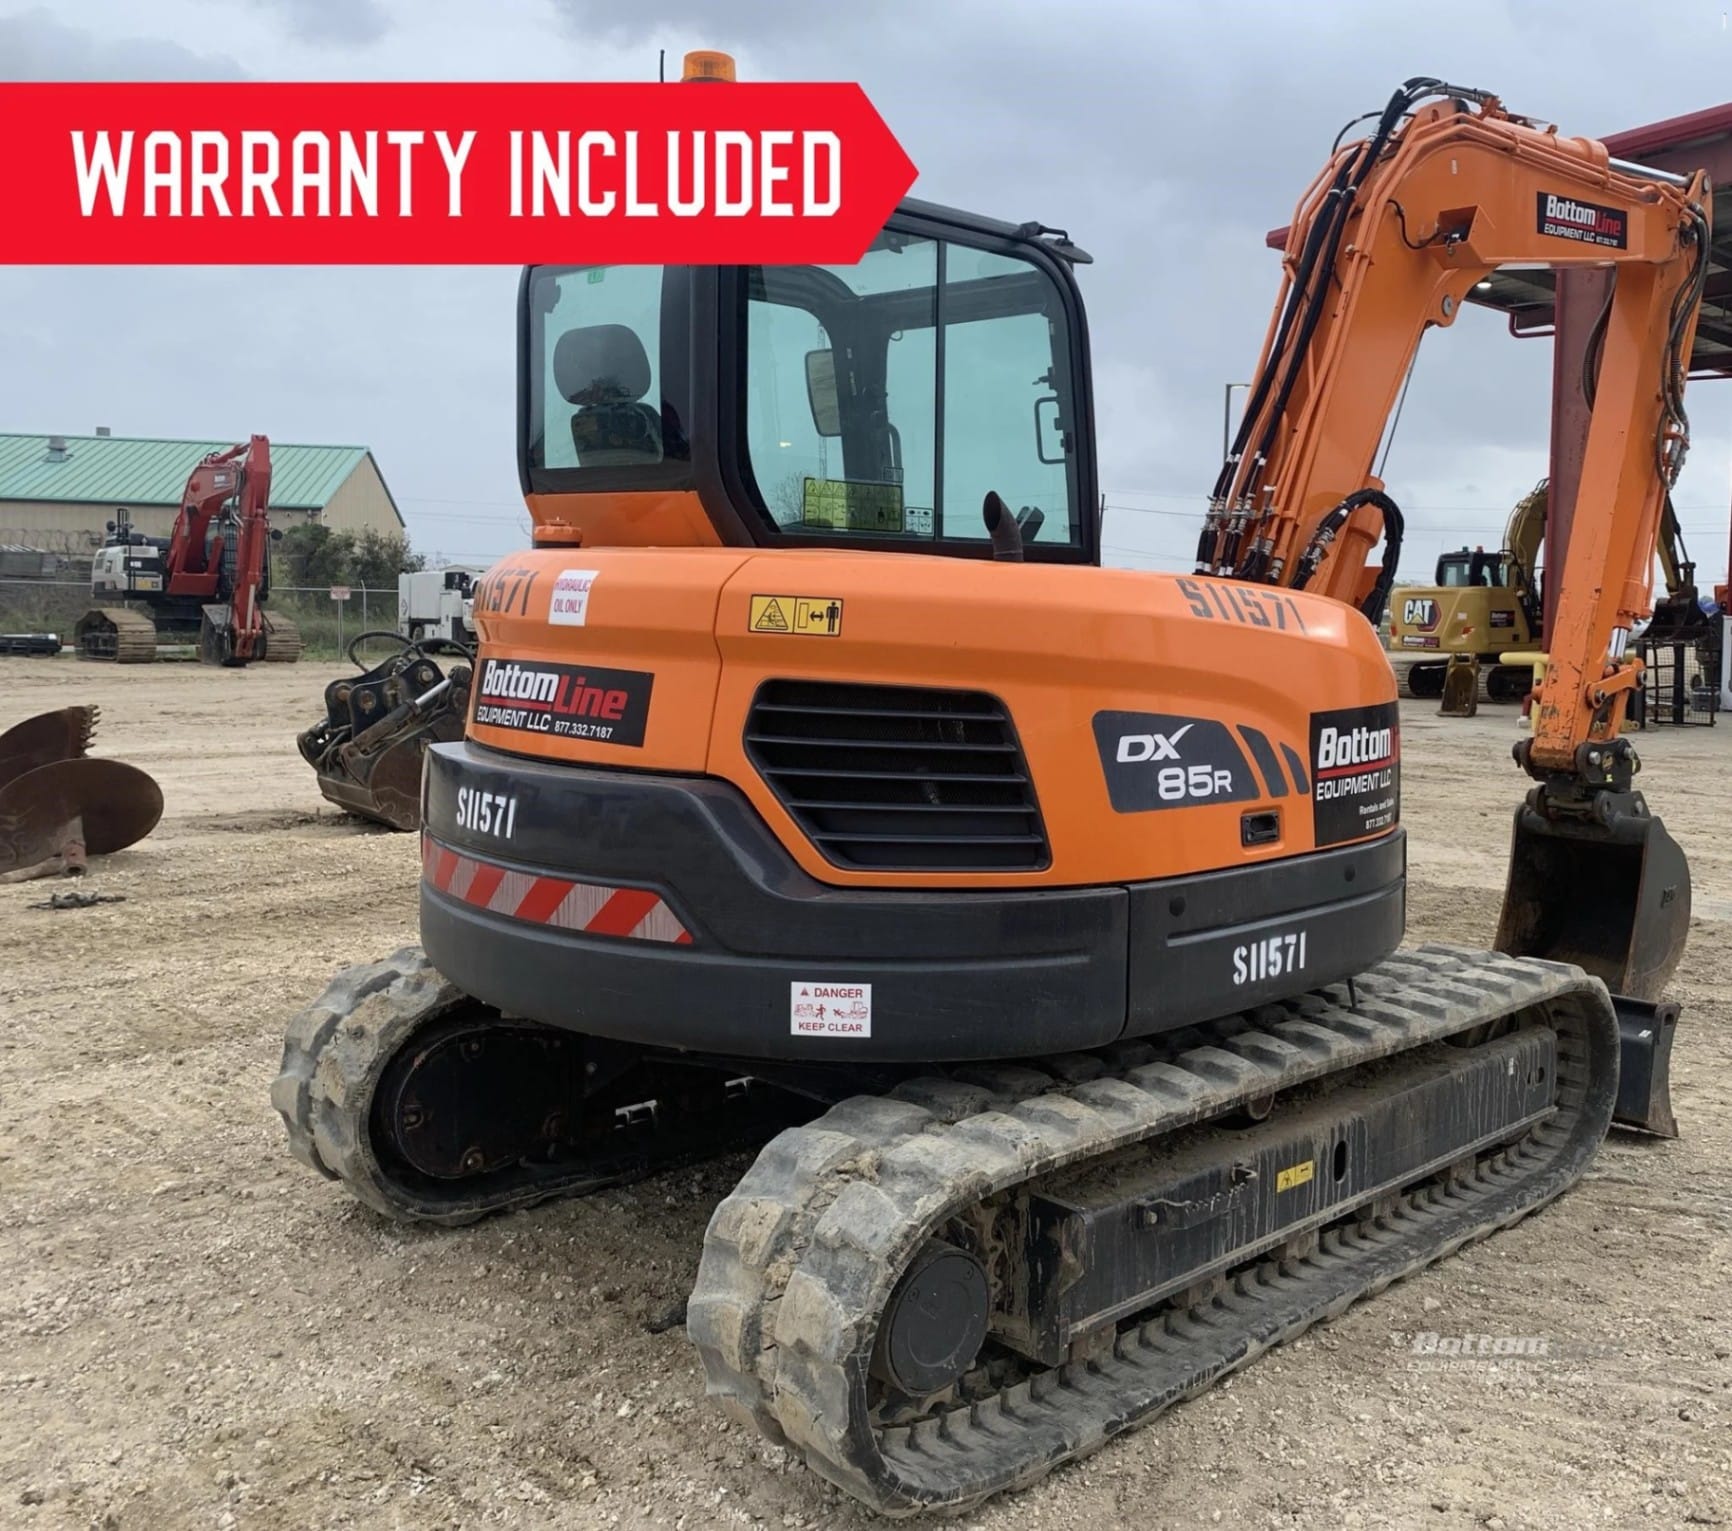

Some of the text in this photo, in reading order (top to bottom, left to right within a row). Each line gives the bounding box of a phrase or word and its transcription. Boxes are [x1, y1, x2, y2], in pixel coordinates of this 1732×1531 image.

[1546, 194, 1621, 235] BottomLine
[1543, 223, 1583, 239] EQUIPMENT
[1583, 231, 1595, 242] LLC
[554, 598, 583, 614] OIL ONLY
[1175, 578, 1308, 636] S11571
[1404, 599, 1433, 624] CAT
[482, 660, 628, 720] BottomLine
[477, 705, 613, 740] EQUIPMENT LLC 877.332.7187
[1116, 723, 1195, 763] DX
[1158, 765, 1232, 800] 85R
[1316, 768, 1392, 801] EQUIPMENT LLC
[456, 787, 517, 839] S11571
[1233, 930, 1306, 985] S11571
[814, 988, 863, 998] DANGER
[798, 1022, 863, 1032] KEEP CLEAR
